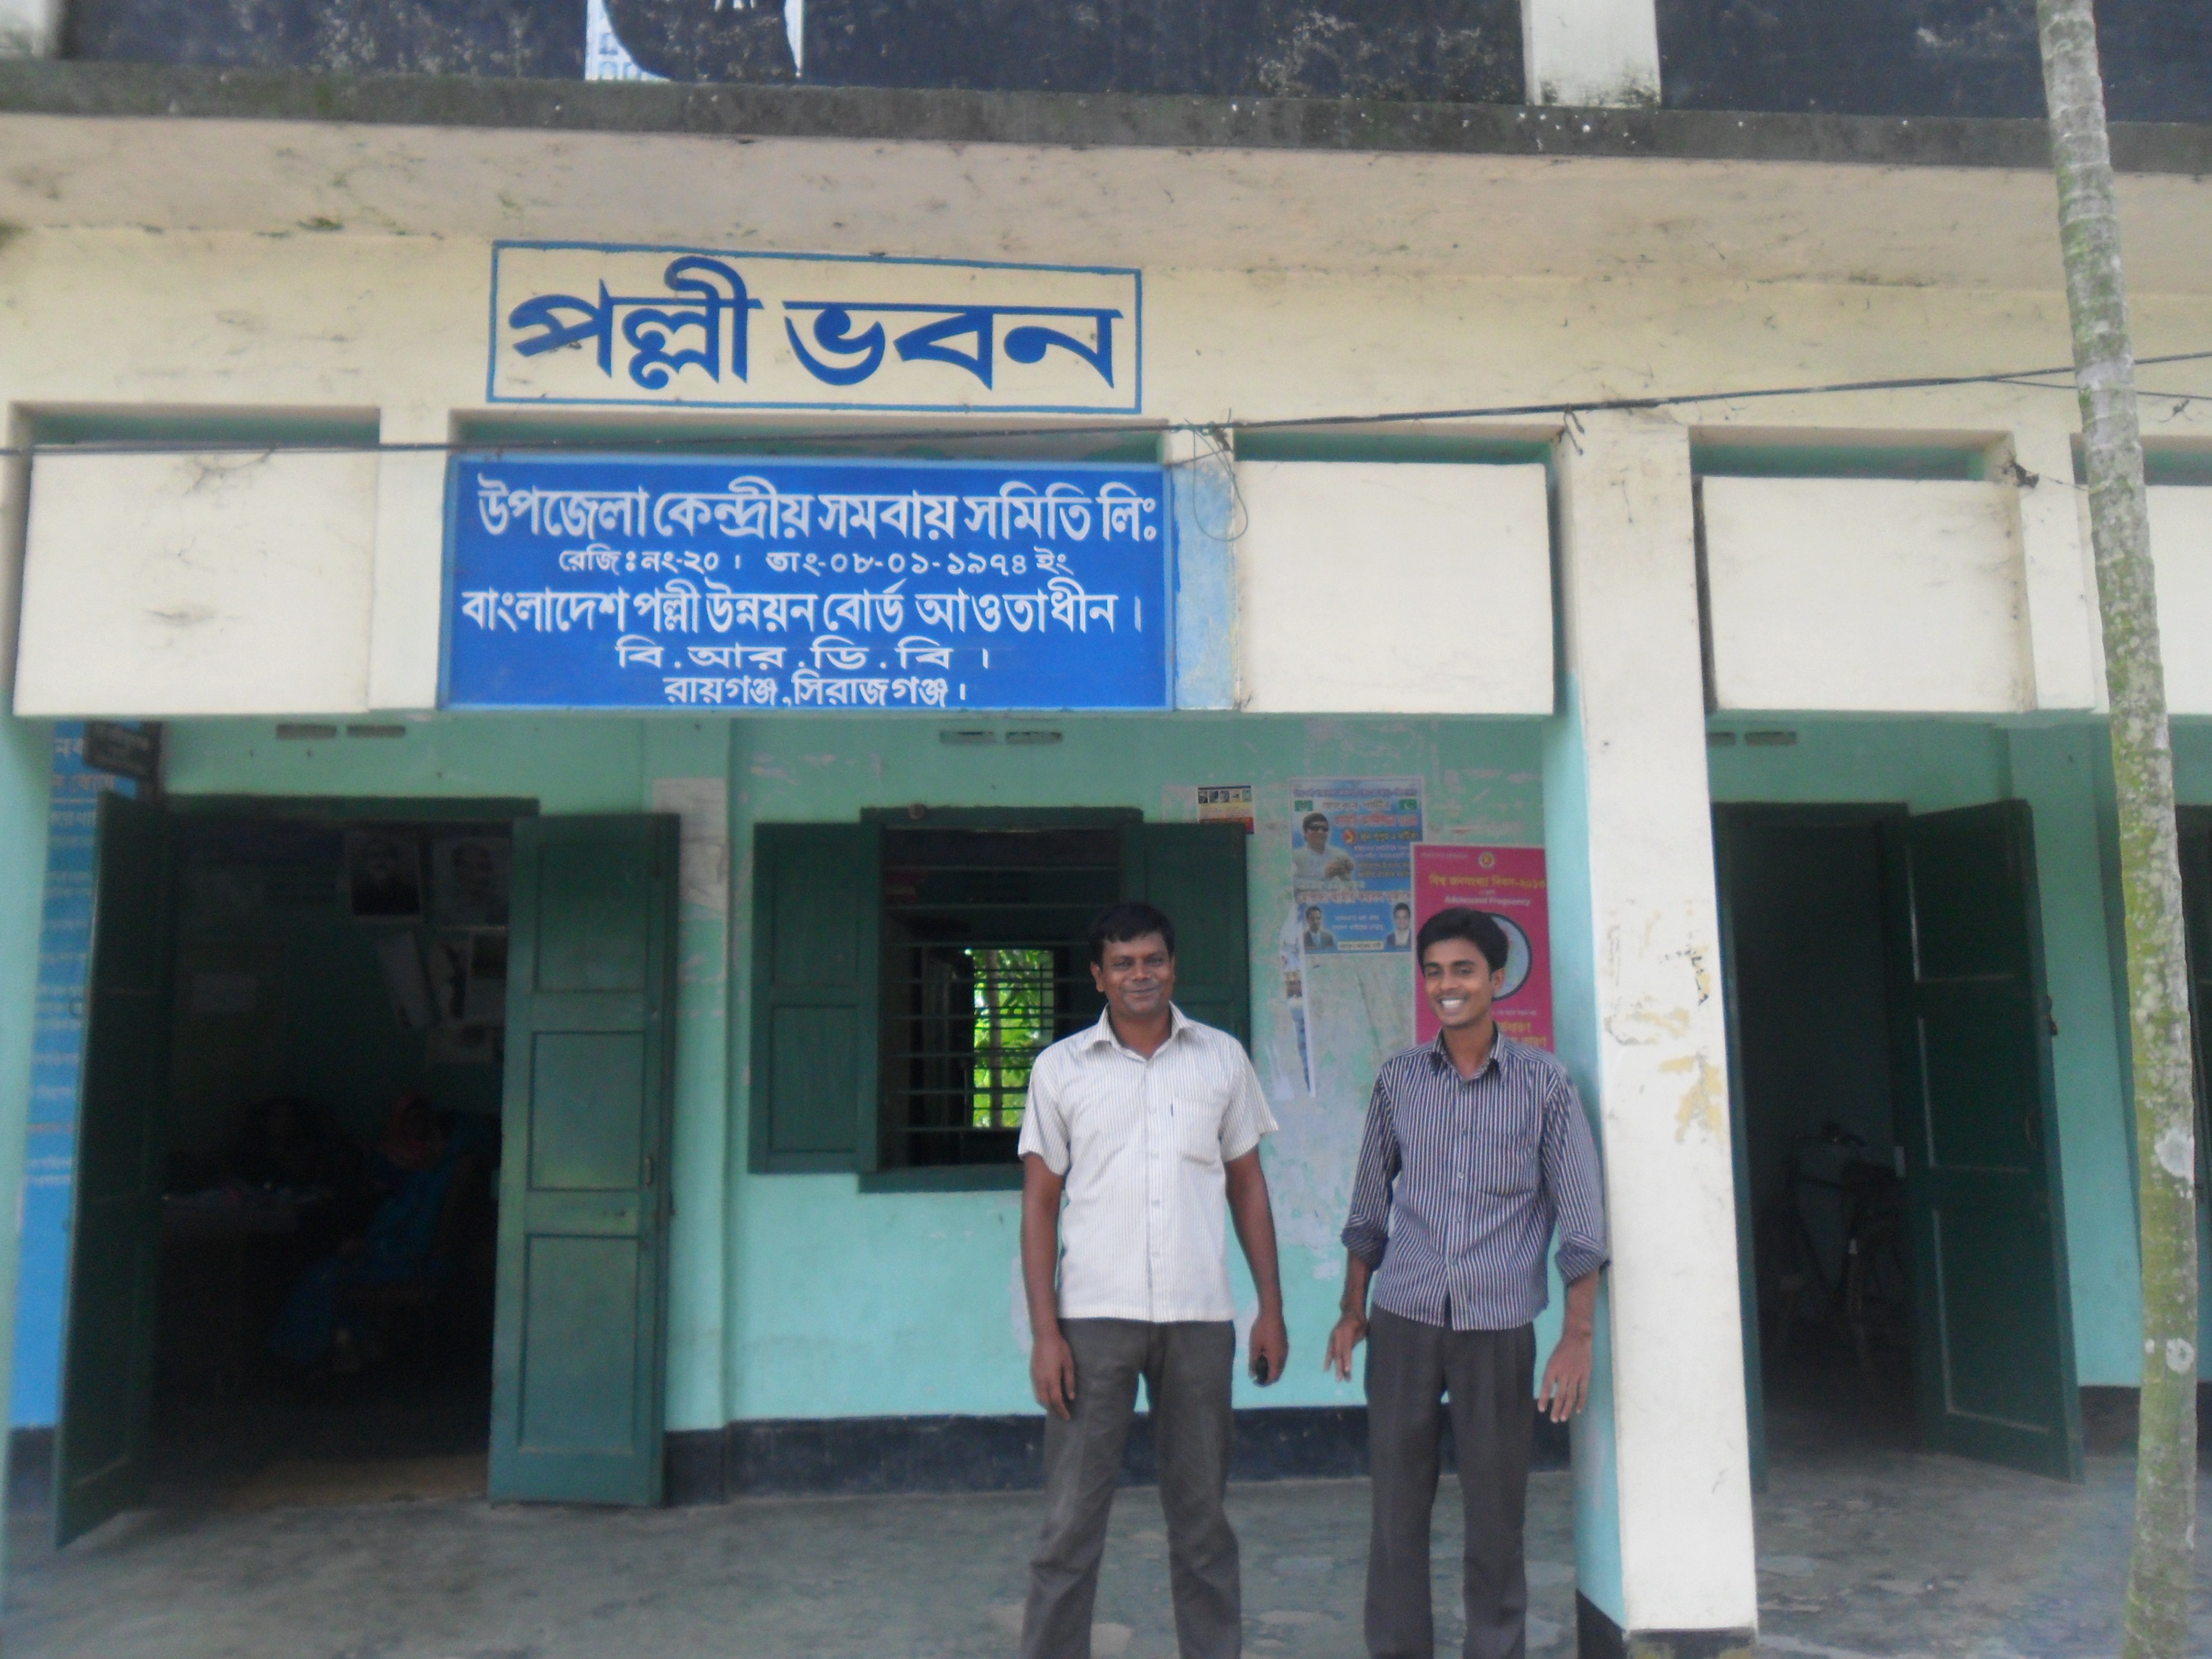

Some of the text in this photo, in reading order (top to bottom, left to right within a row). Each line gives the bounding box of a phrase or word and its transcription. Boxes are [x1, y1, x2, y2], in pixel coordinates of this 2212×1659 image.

[508, 255, 1125, 390] পল্লী ভবন
[477, 472, 650, 541] উপজেলা
[653, 475, 815, 539] কেন্দ্রীয়
[817, 488, 959, 541] সমবায়
[962, 480, 1093, 541] সমিতি
[1033, 545, 1075, 576] ইং
[462, 585, 630, 633] বাংলাদেশ
[633, 577, 701, 633] পল্লী
[704, 576, 818, 633] উন্নয়ন
[823, 578, 907, 633] বোর্ড
[914, 576, 1119, 633] আওতাধীন
